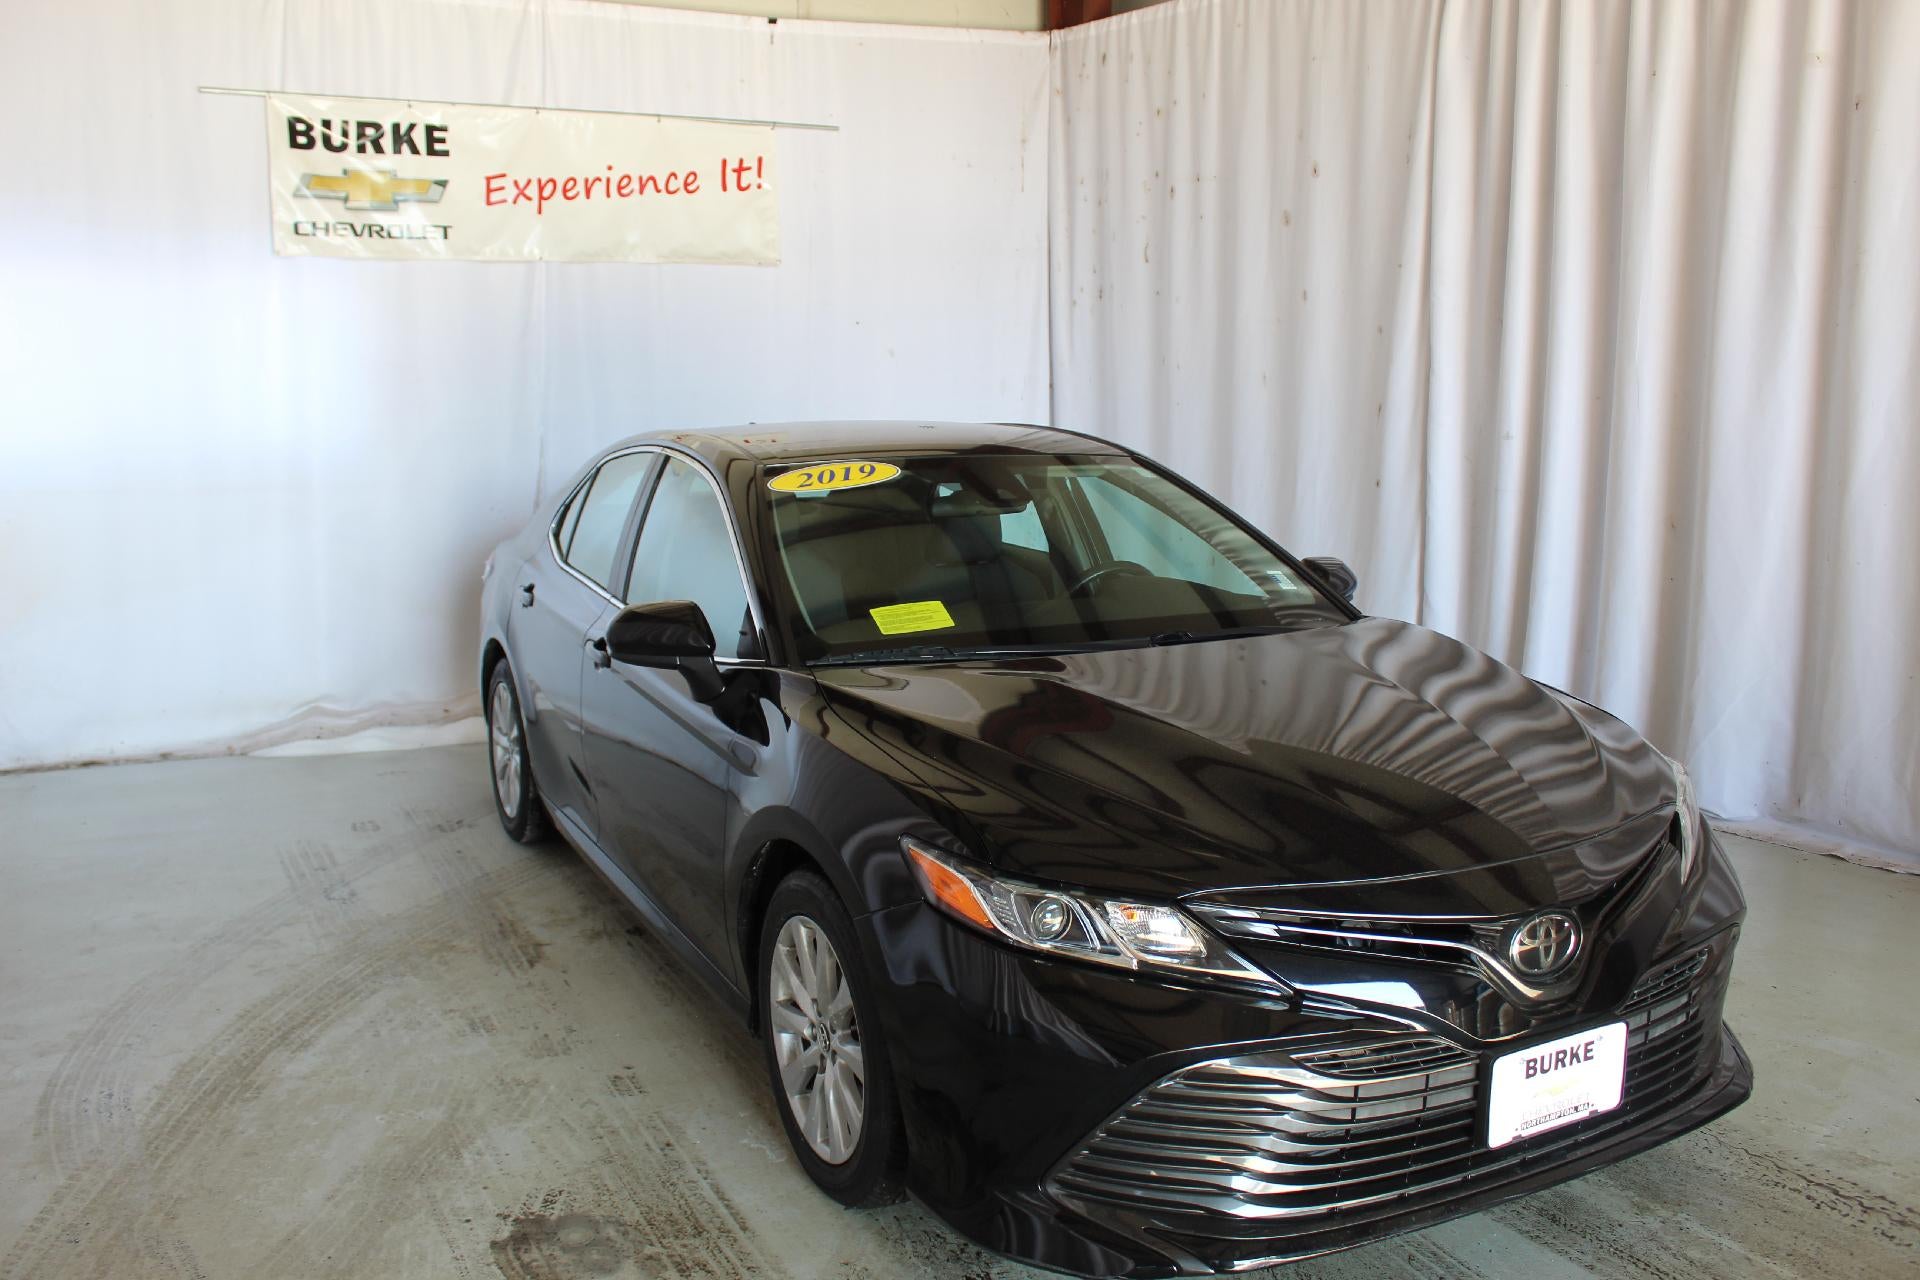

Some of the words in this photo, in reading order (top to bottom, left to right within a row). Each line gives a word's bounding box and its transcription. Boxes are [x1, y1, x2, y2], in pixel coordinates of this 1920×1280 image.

[287, 116, 450, 157] BURKE
[484, 164, 701, 215] Experience
[720, 156, 764, 193] It!
[293, 220, 452, 240] CHEVROLET
[797, 463, 876, 488] 2019
[1525, 1040, 1595, 1079] BURKE
